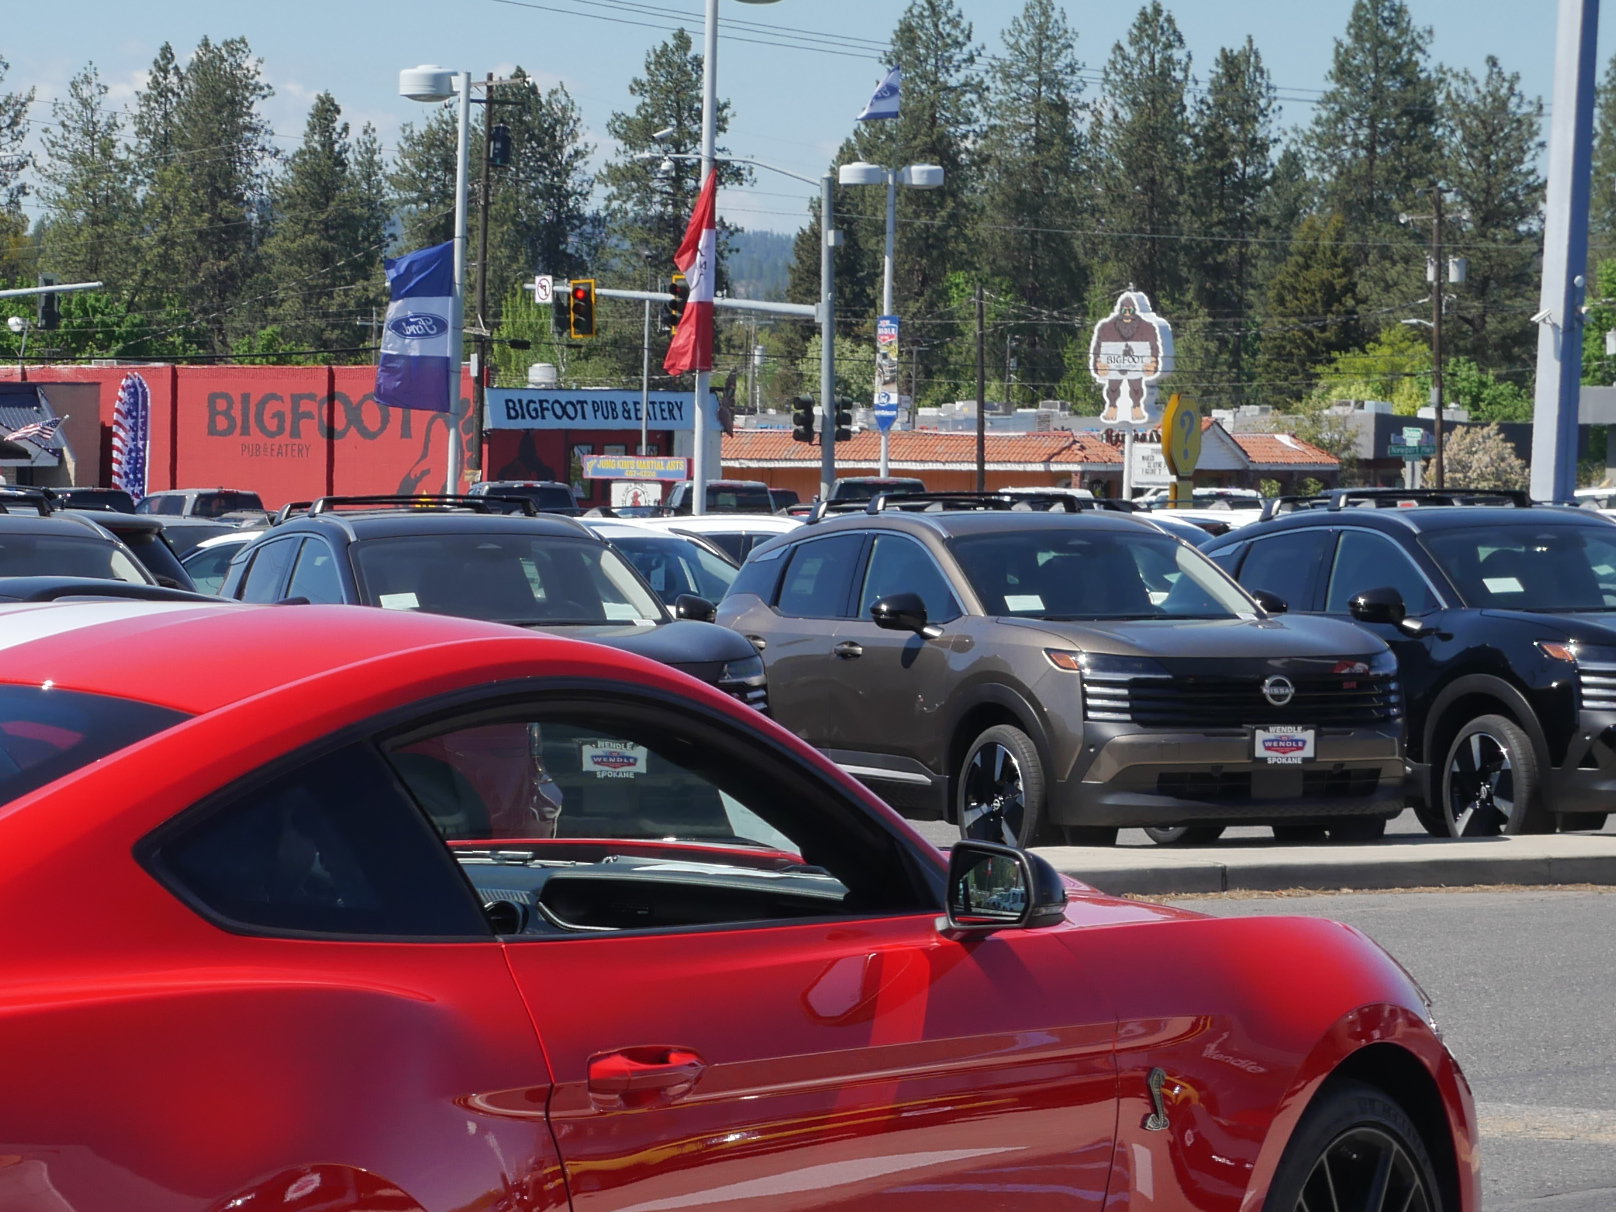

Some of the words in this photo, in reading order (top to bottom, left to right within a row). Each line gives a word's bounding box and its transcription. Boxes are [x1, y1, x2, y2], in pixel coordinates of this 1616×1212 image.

[1107, 355, 1145, 364] BIGFOOT
[505, 398, 589, 421] BIGFOOT
[592, 399, 619, 421] PUB
[622, 400, 632, 421] &
[637, 460, 665, 470] MARTIAL
[667, 460, 684, 471] ARTS
[1263, 686, 1295, 695] NISSAN
[596, 771, 635, 779] SPOKANE
